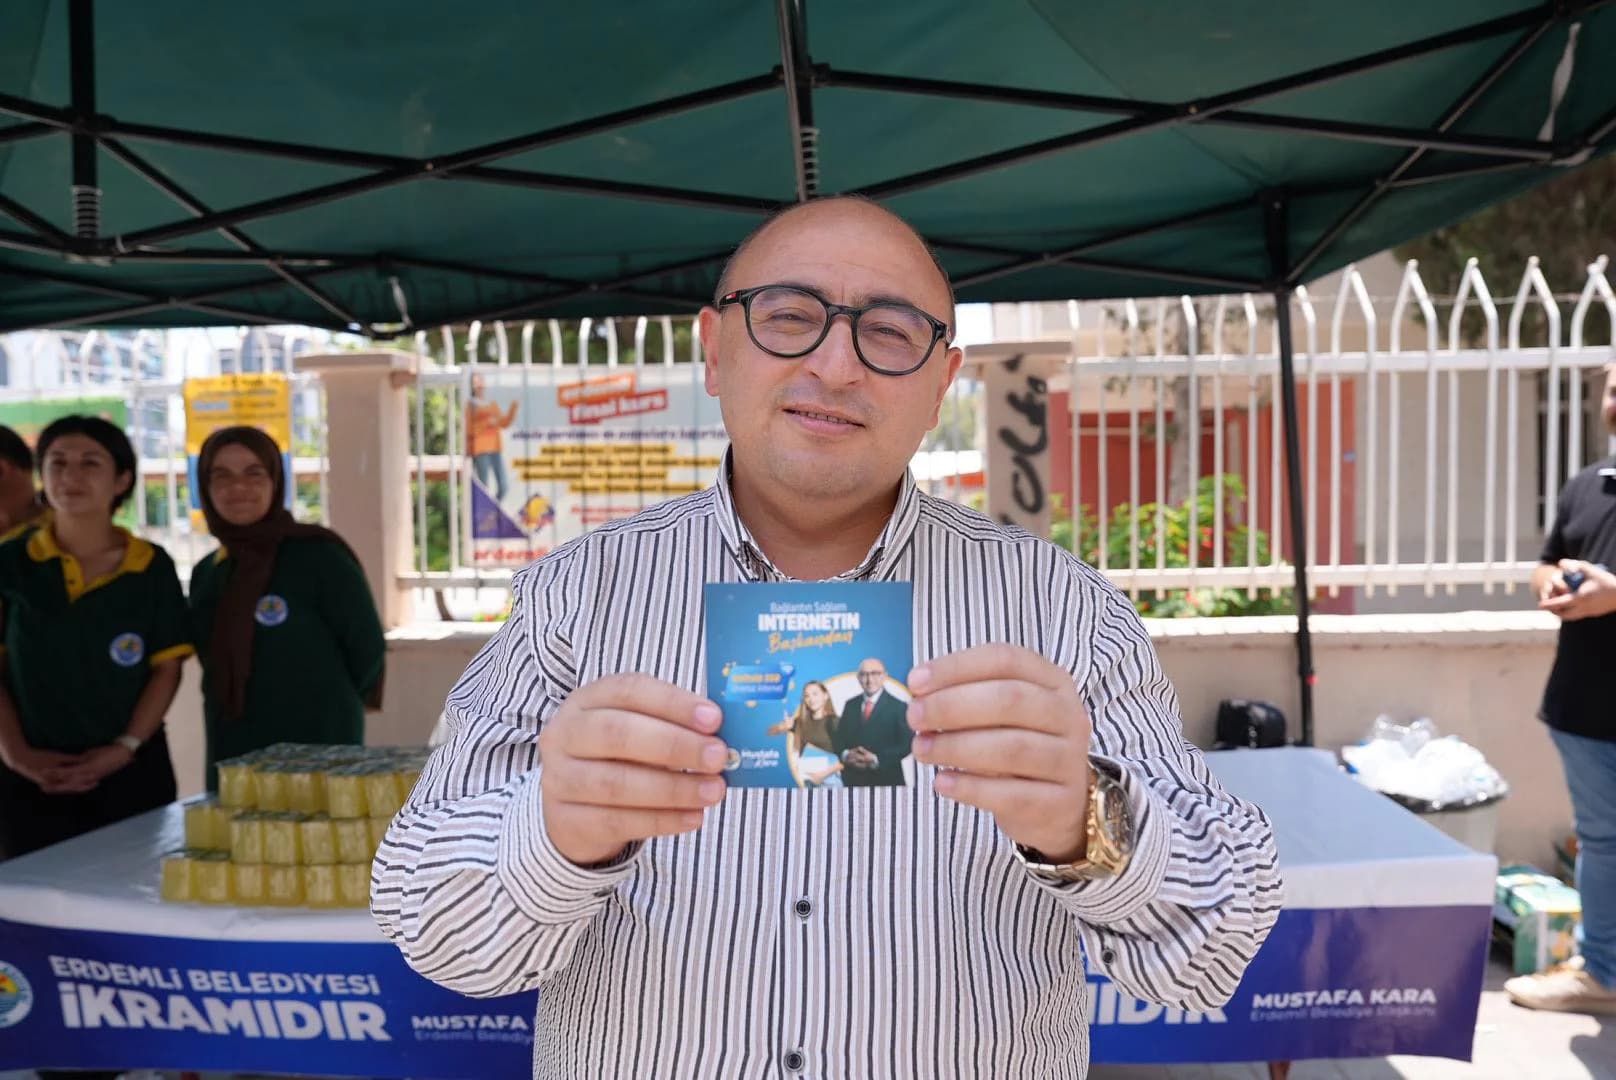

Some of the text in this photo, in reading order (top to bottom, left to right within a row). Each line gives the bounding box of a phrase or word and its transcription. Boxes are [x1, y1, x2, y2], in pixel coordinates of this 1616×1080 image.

[48, 955, 381, 995] ERDEMLİ BELEDİYESİ
[58, 981, 392, 1041] İKRAMIDIR
[1252, 988, 1437, 1009] MUSTAFA KARA
[411, 1015, 528, 1030] MUSTAFA
